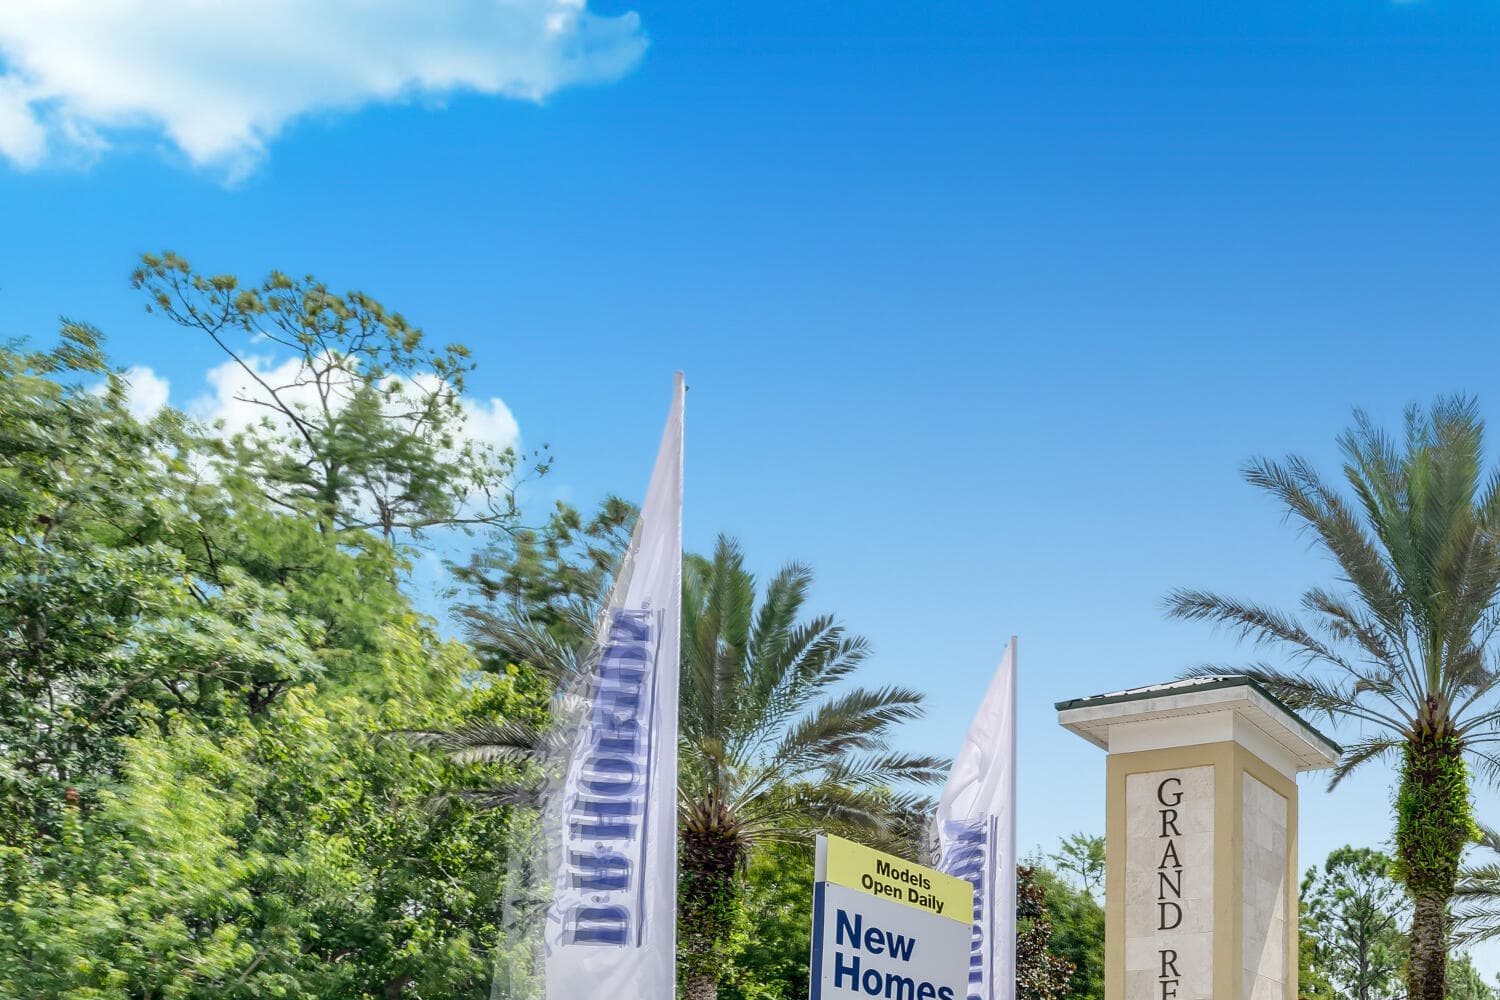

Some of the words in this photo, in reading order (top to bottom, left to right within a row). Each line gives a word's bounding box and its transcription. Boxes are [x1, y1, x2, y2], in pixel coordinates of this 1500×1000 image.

[876, 859, 931, 890] Models
[1157, 777, 1184, 931] GRAND
[861, 874, 902, 899] Open
[908, 888, 944, 914] Daily
[836, 909, 916, 962] New
